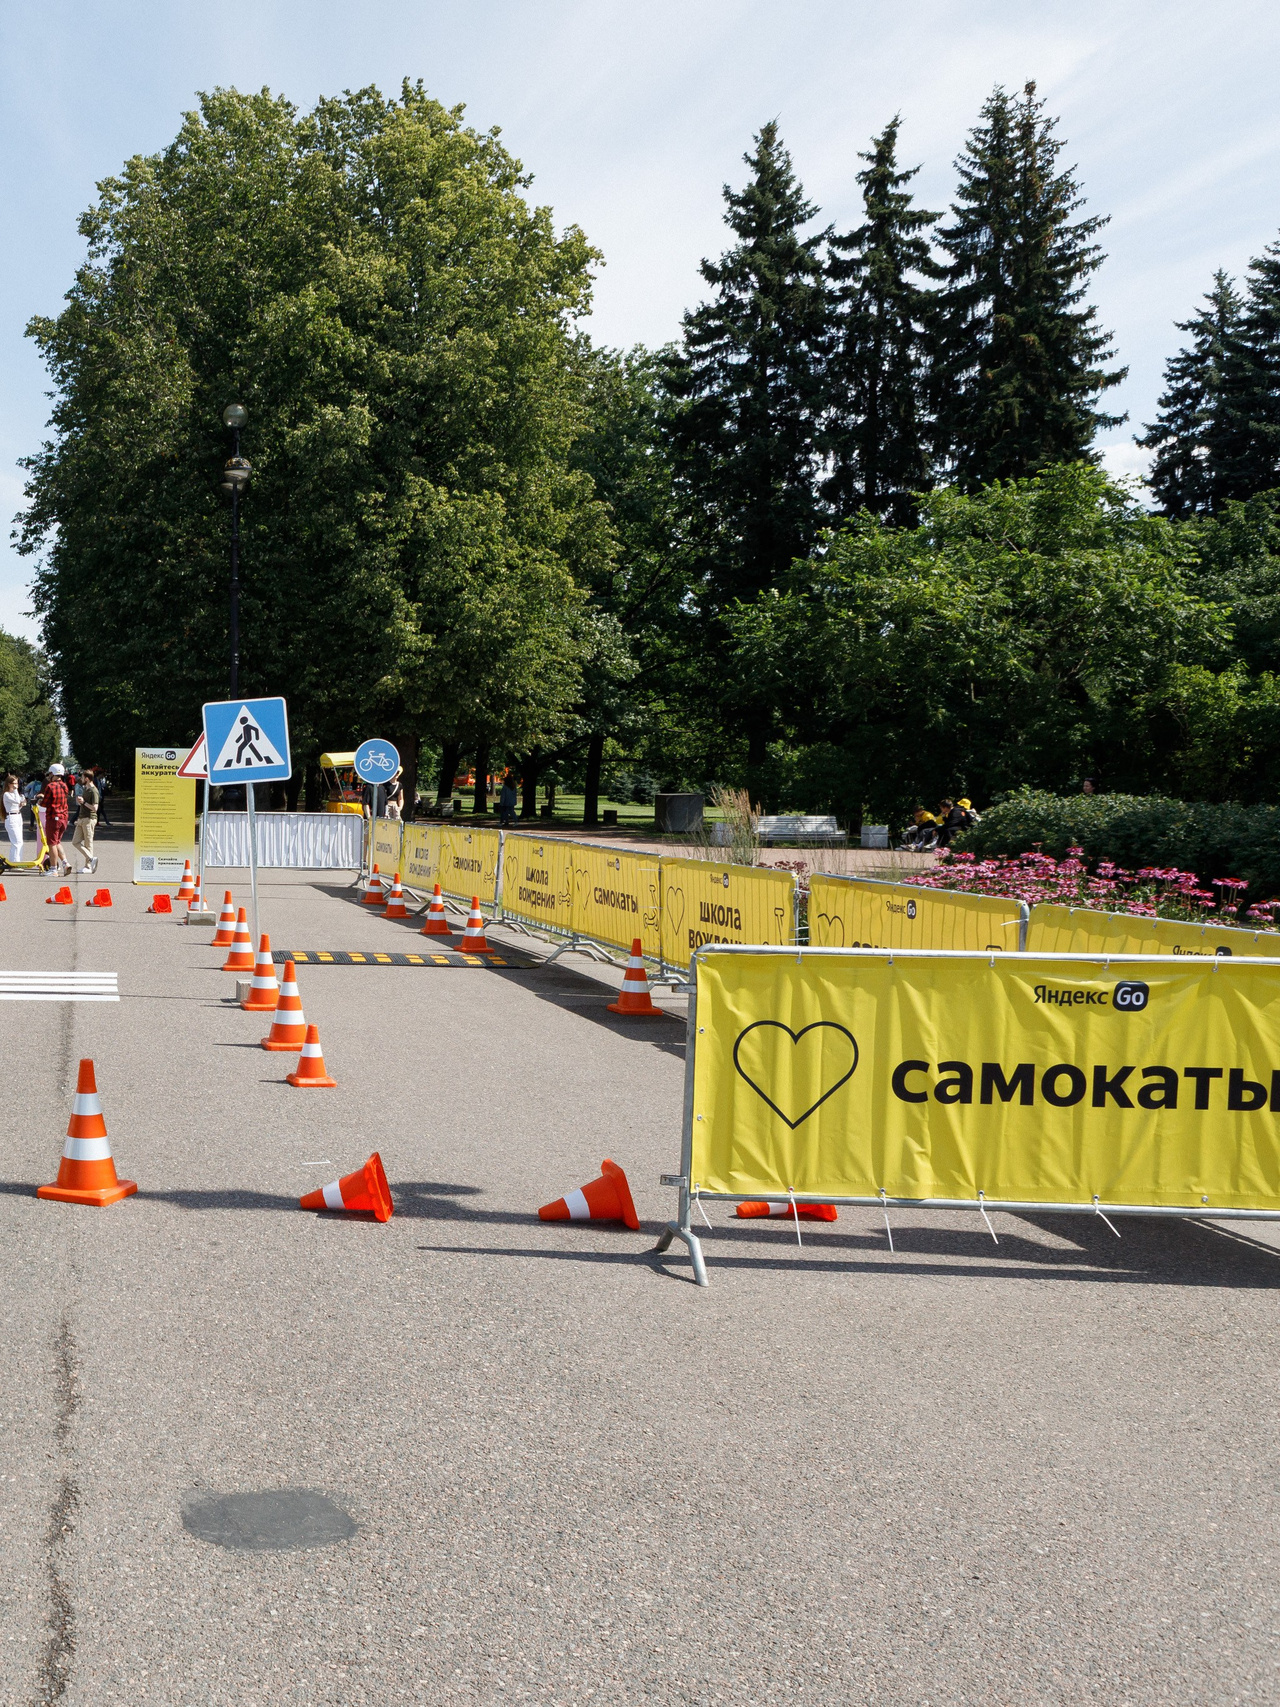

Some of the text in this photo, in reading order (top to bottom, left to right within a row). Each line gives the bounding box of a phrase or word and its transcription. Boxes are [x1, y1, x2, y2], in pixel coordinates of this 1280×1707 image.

[165, 751, 176, 760] Go
[525, 866, 549, 886] школа
[518, 886, 556, 910] вождения
[593, 886, 639, 914] самокаты
[907, 902, 916, 917] Go
[700, 901, 741, 930] школа
[1034, 985, 1146, 1007] Яндекс Go
[891, 1060, 1280, 1112] самокаты
